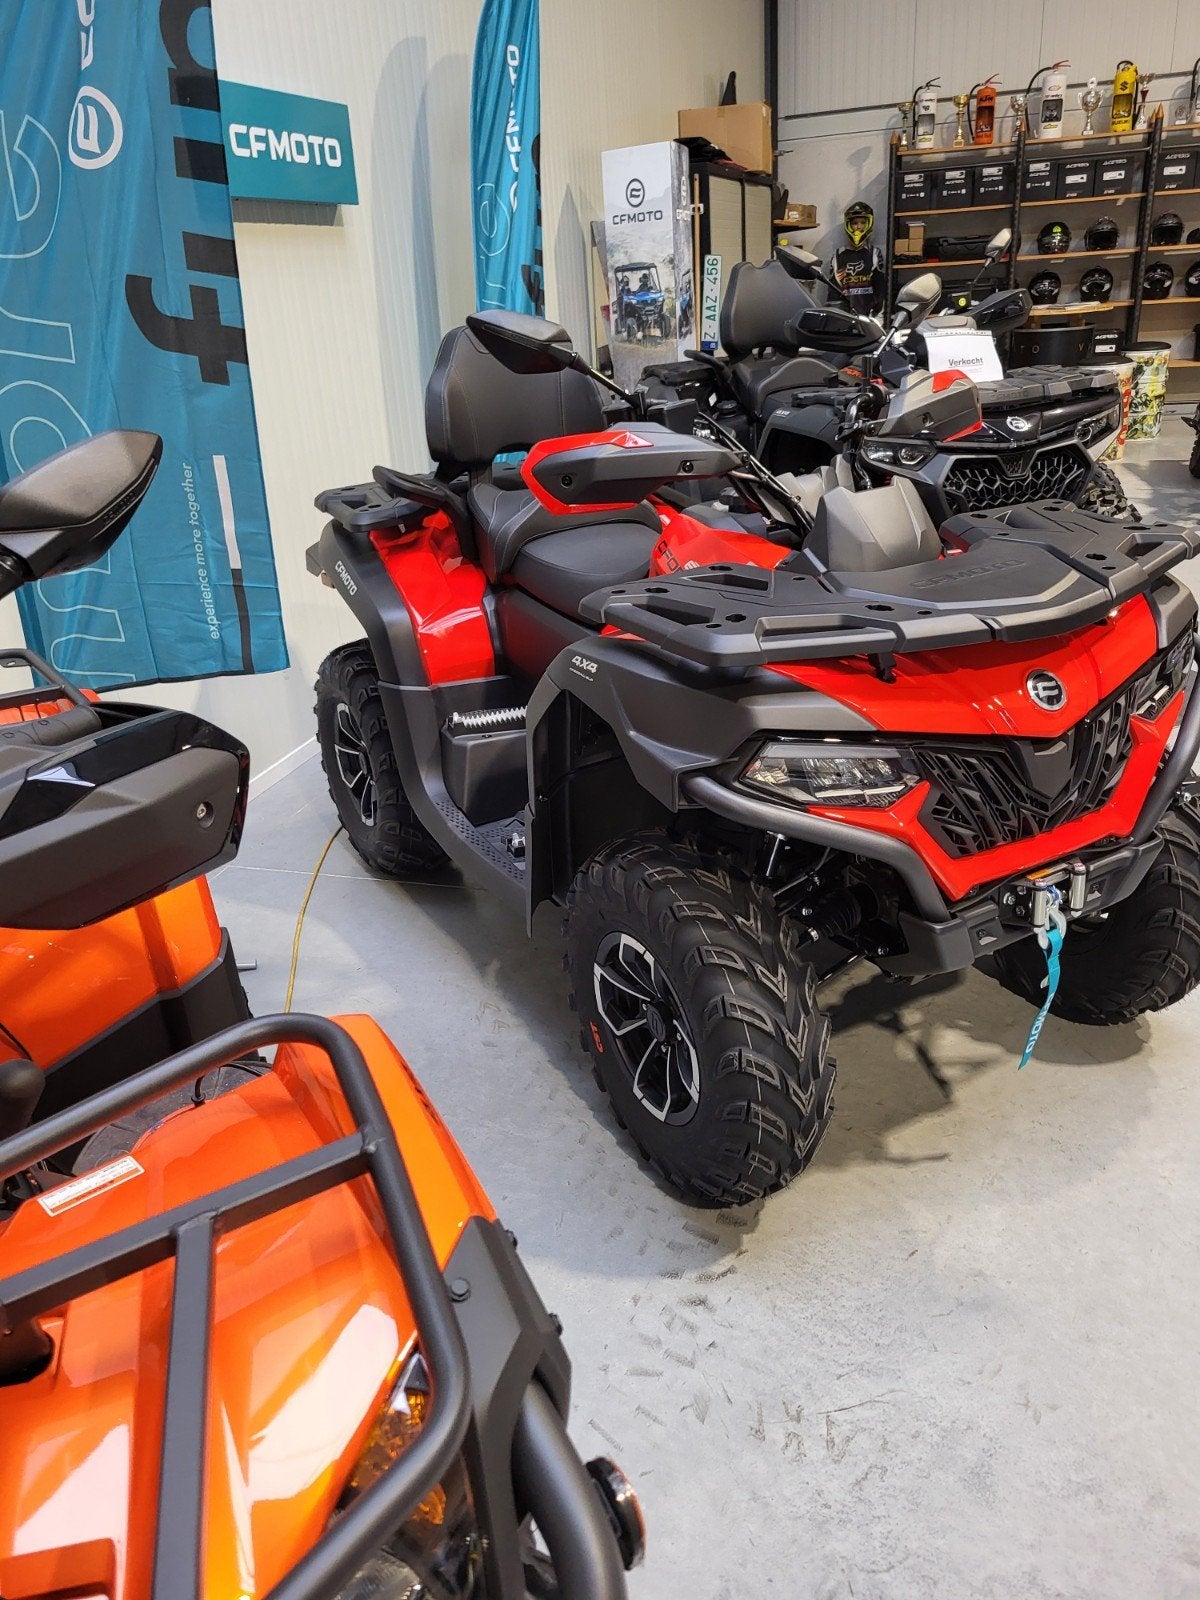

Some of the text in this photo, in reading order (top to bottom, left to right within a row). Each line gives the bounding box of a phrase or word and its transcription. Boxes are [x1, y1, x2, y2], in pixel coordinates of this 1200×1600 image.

[228, 123, 342, 168] CFMOTO
[612, 209, 664, 226] CFMOTO
[948, 357, 984, 367] Verkocht
[181, 463, 221, 640] experience more together
[335, 560, 358, 596] CFMOTO
